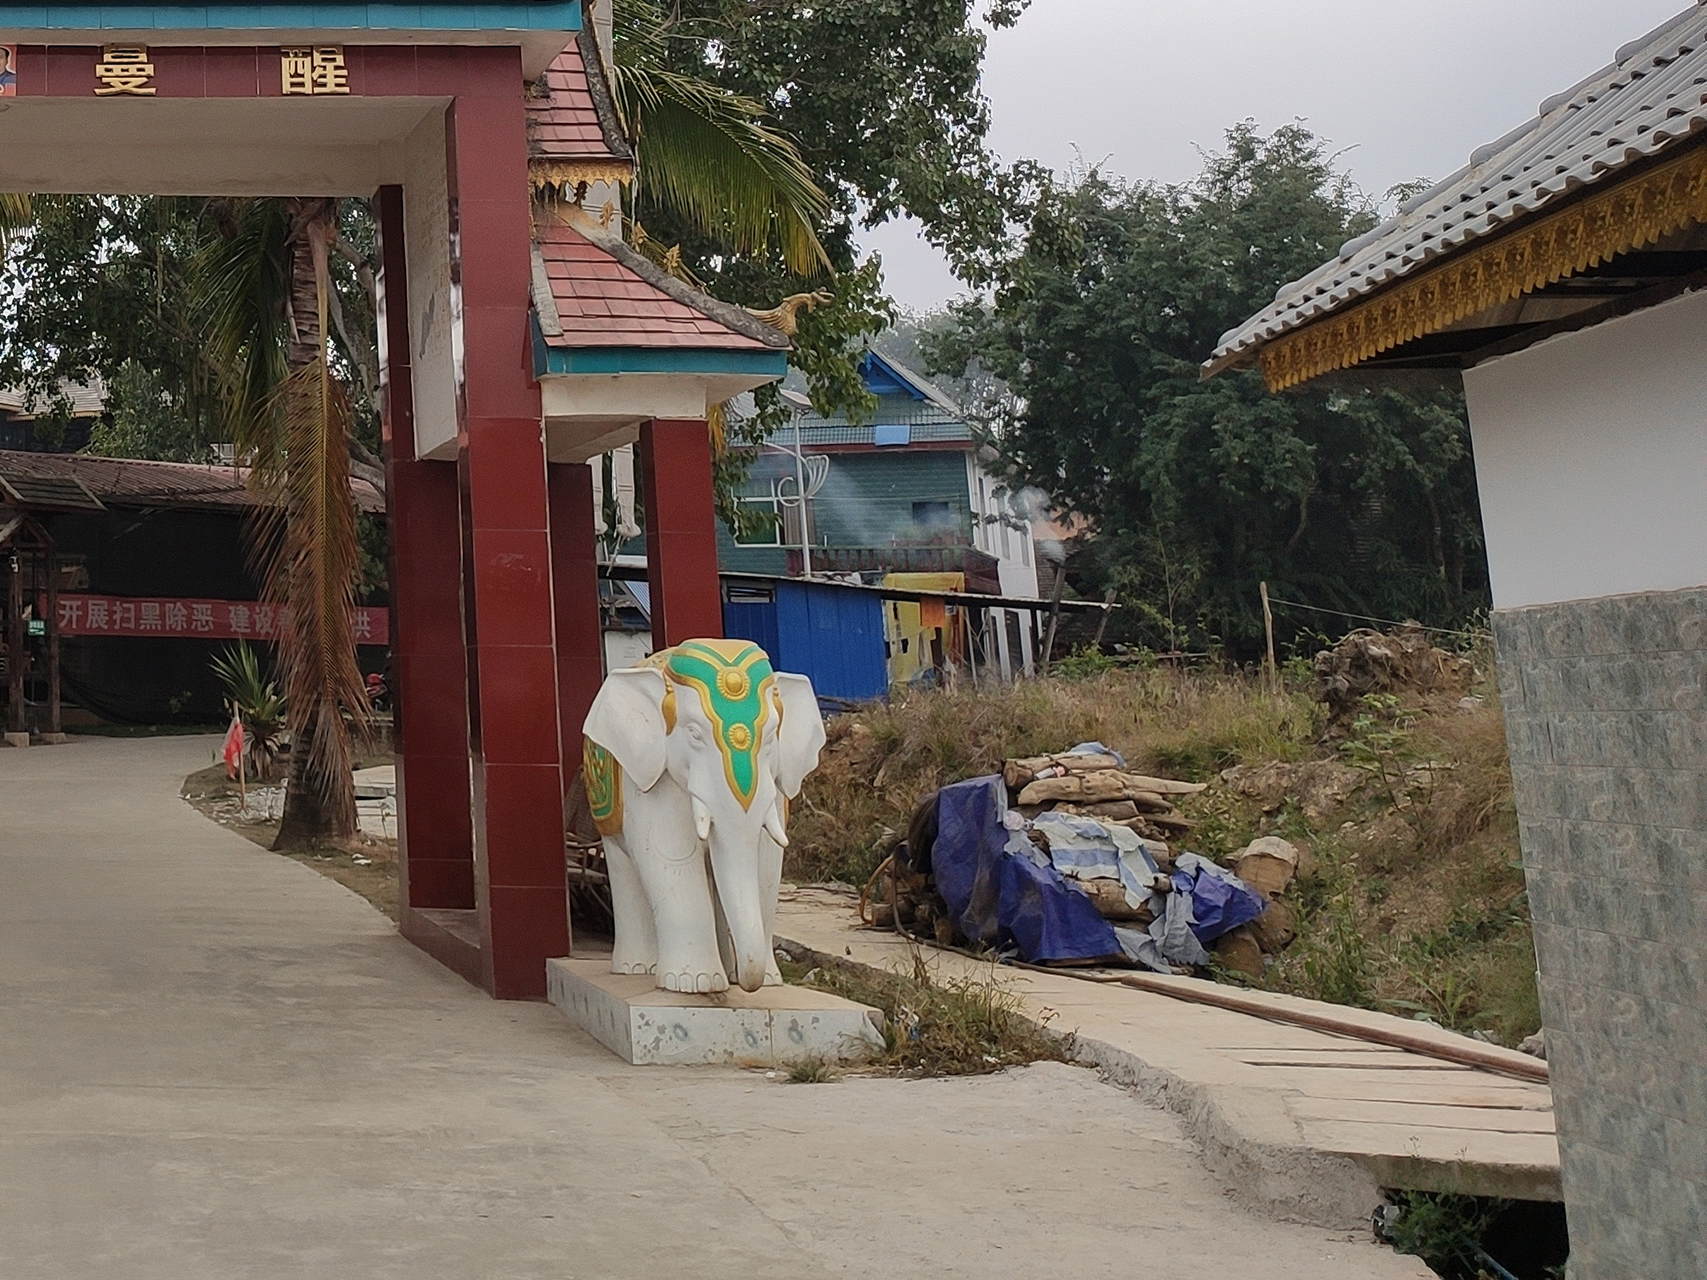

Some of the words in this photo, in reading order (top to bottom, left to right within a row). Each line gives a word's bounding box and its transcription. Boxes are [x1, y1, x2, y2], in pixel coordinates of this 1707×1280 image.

[93, 44, 351, 96] 曼醒
[58, 600, 214, 632] 开展扫黑除恶
